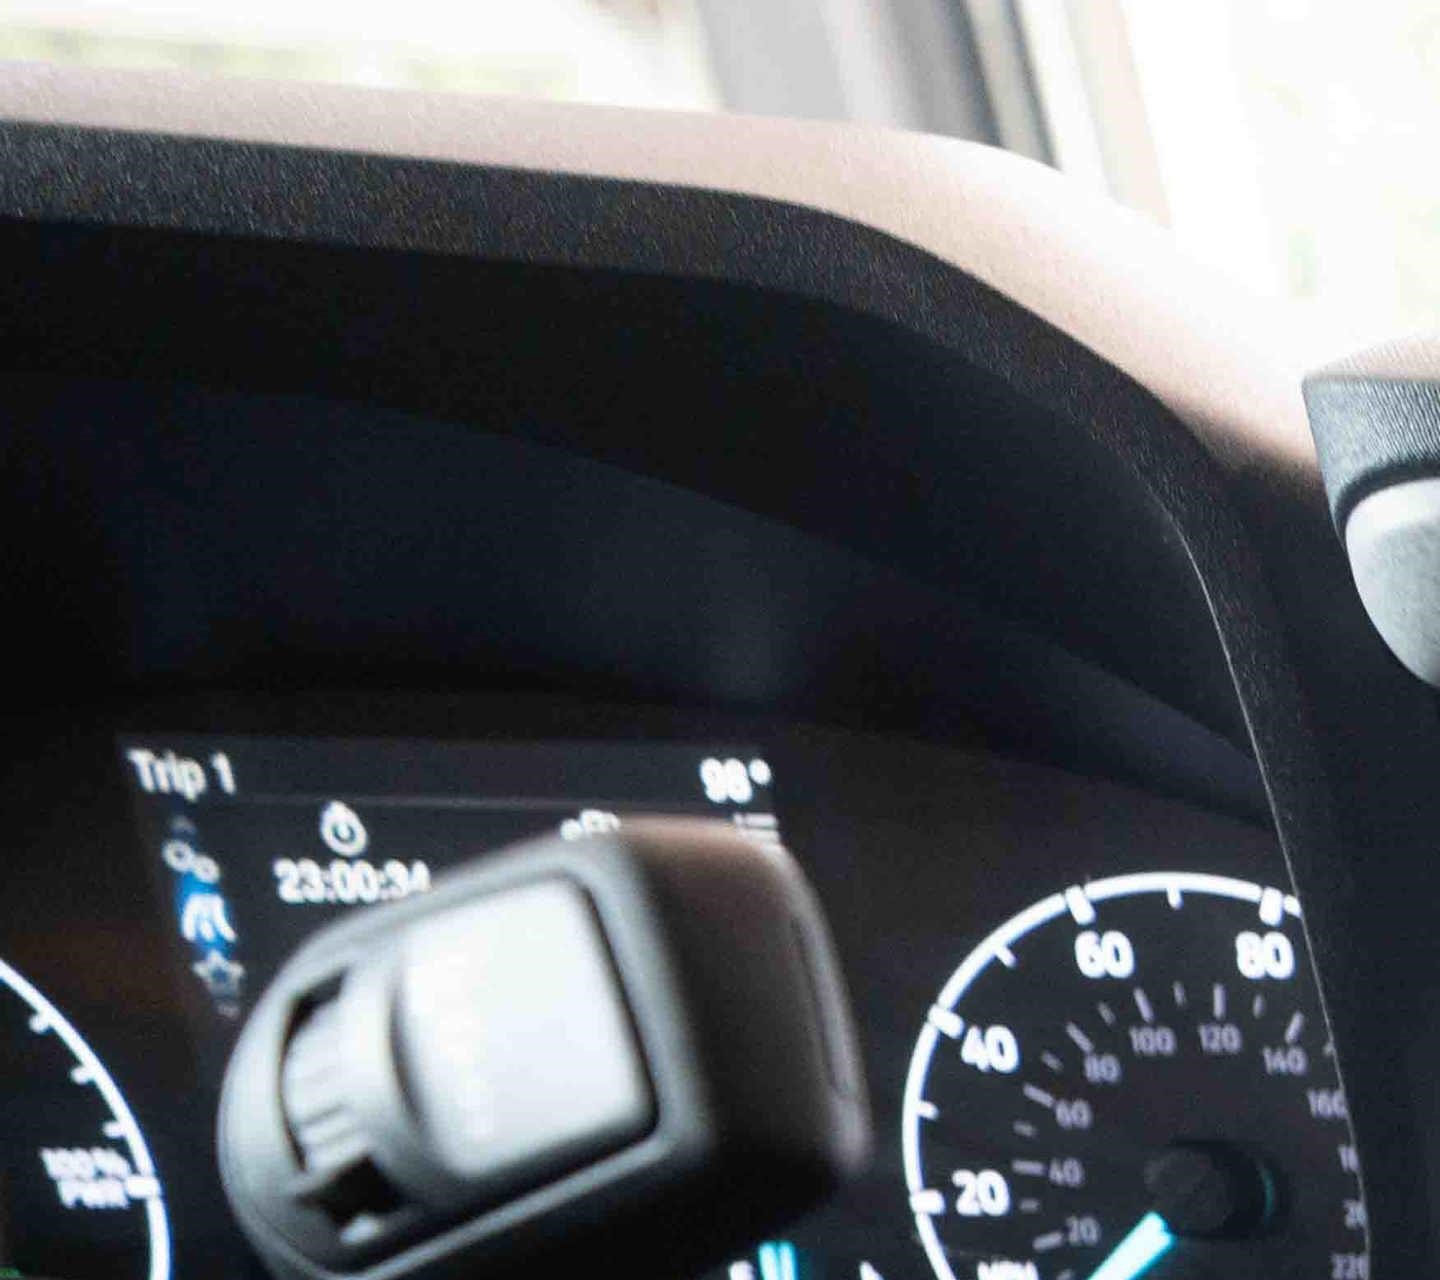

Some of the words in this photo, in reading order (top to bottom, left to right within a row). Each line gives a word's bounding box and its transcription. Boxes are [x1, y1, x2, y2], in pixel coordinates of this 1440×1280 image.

[128, 749, 204, 799] Trip
[212, 752, 236, 794] 1
[273, 859, 432, 903] 23:00:34
[1074, 930, 1136, 979] 60
[1235, 930, 1295, 979] 80
[960, 1025, 1020, 1073] 40
[1130, 1024, 1176, 1056] 100
[1198, 1023, 1241, 1054] 120
[1083, 1054, 1121, 1084] 80
[1264, 1042, 1307, 1075] 140
[1054, 1098, 1094, 1130] 60
[1048, 1156, 1084, 1187] 40
[951, 1169, 1010, 1216] 20
[1065, 1216, 1099, 1247] 20
